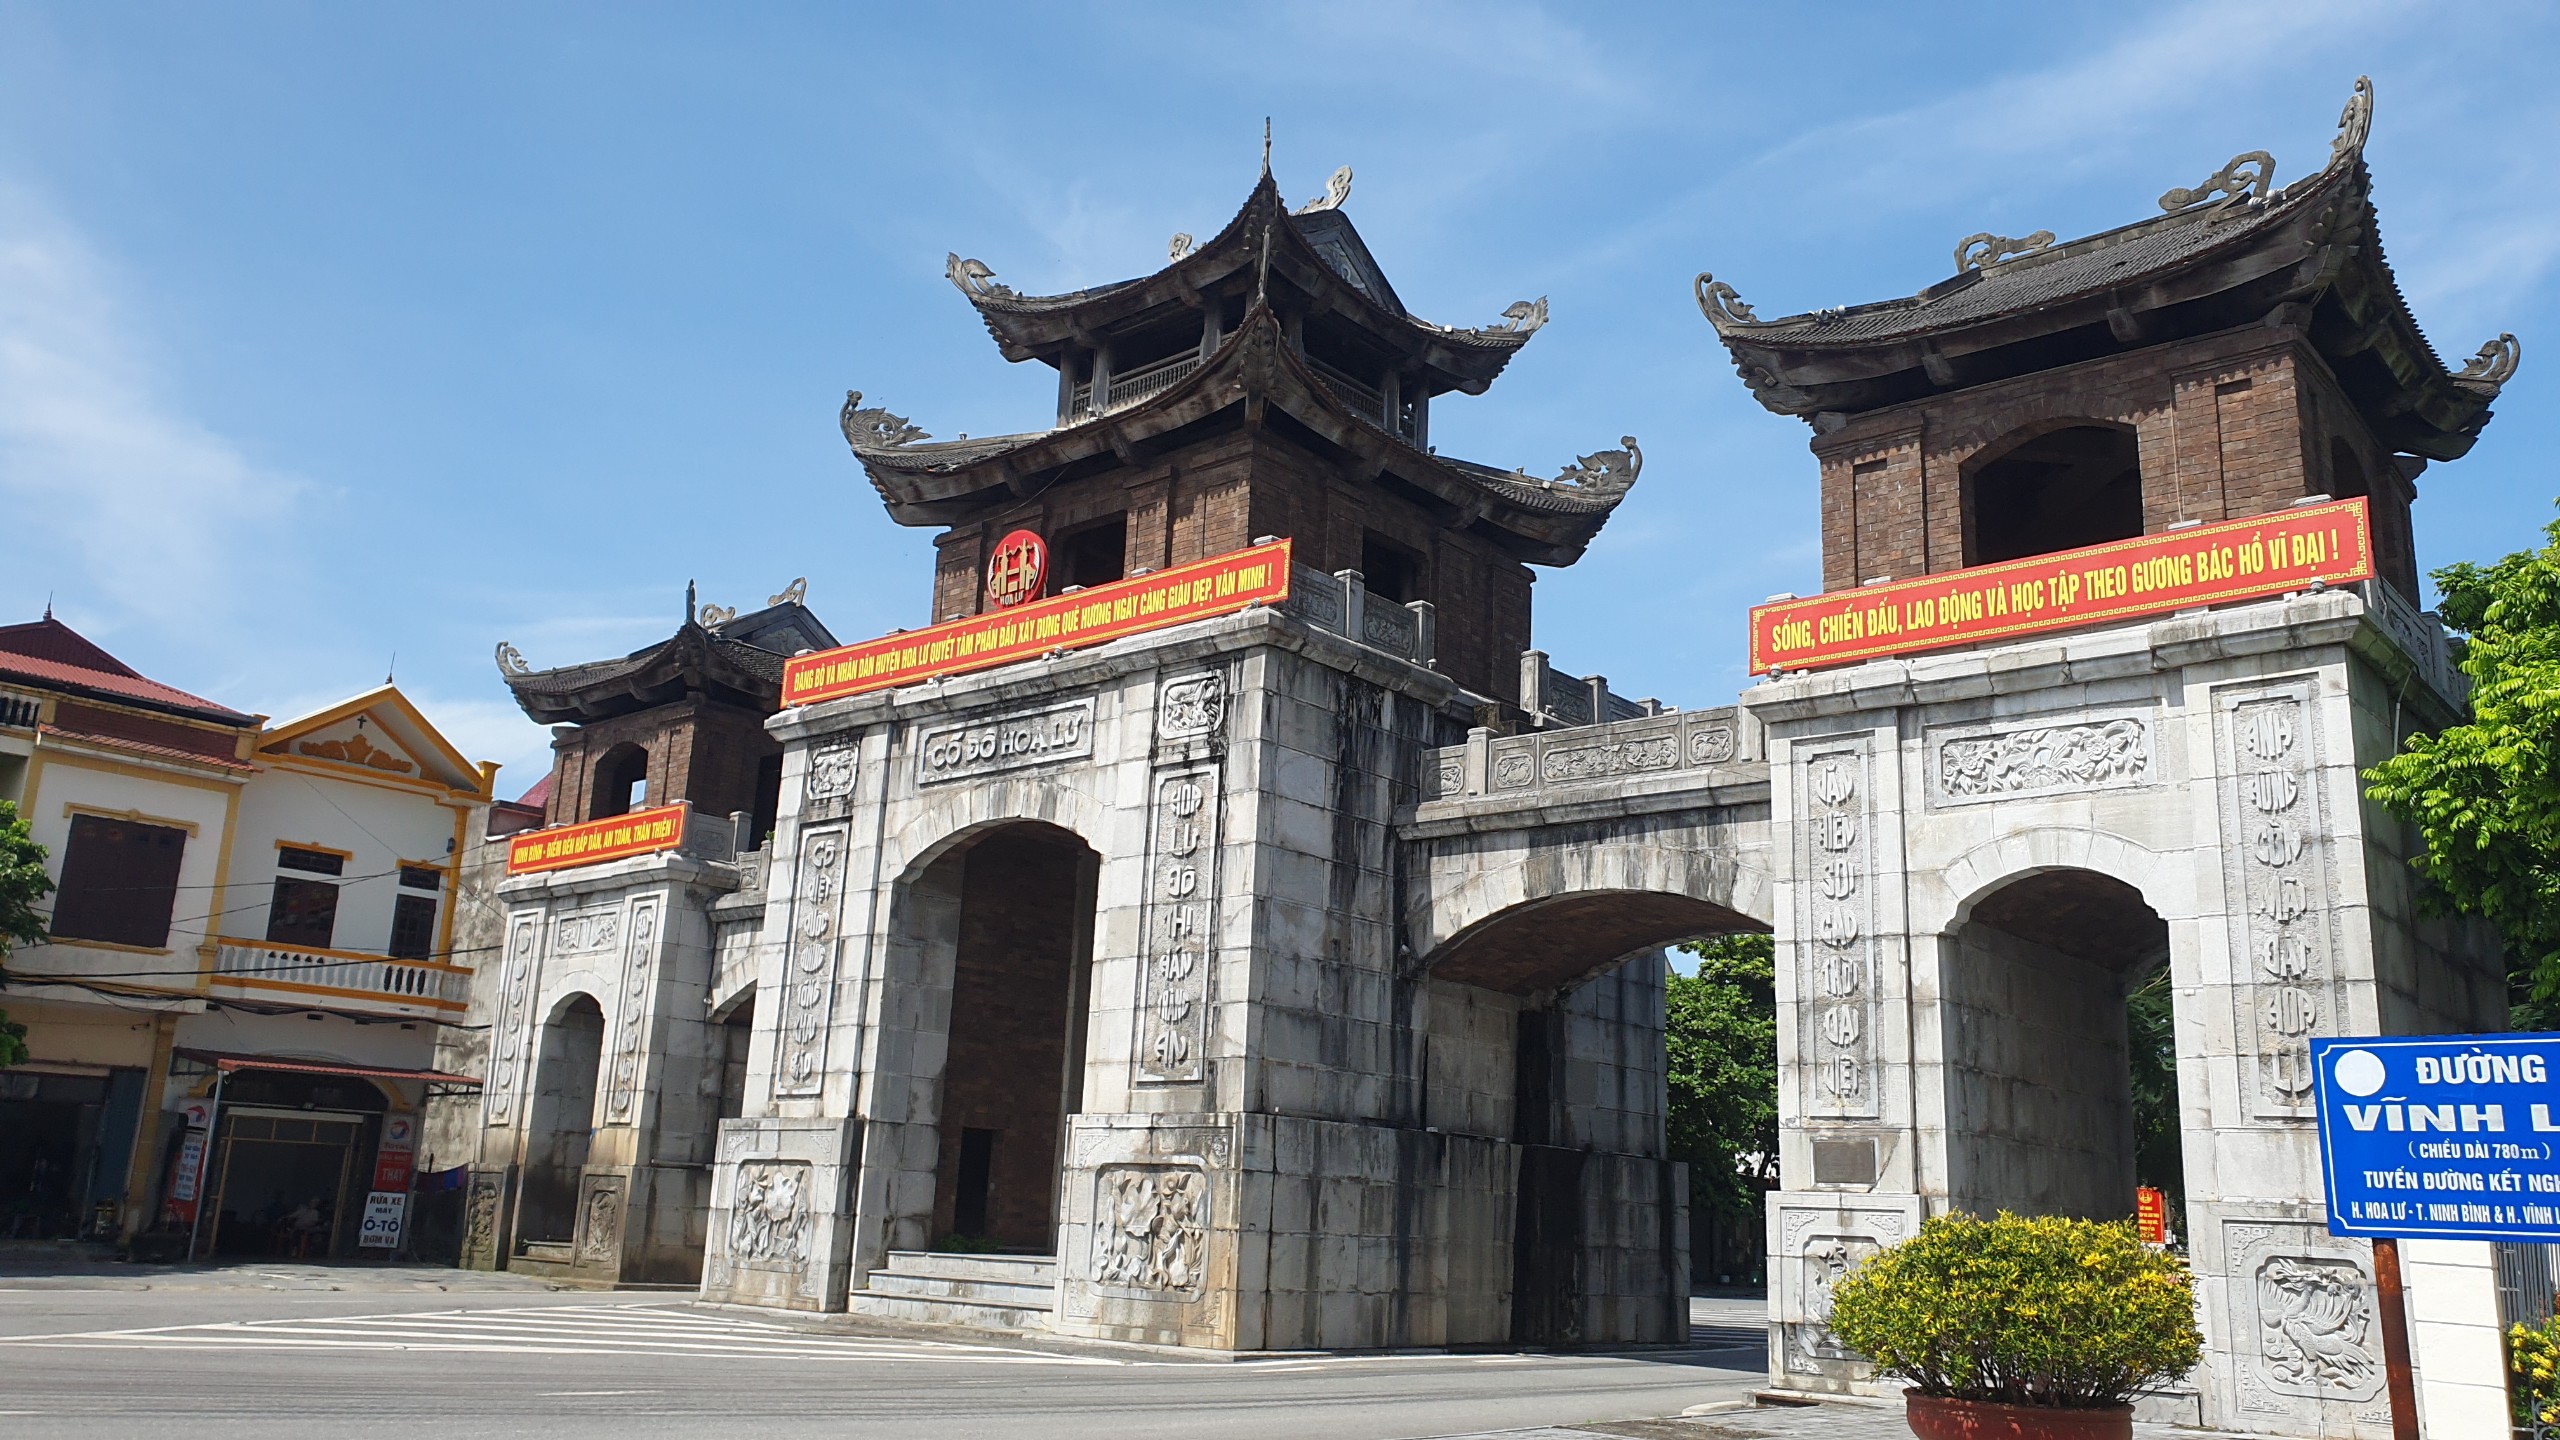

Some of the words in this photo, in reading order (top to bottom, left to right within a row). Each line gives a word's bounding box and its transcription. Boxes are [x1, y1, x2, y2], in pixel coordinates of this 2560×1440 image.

[1000, 593, 1014, 605] HOA
[1772, 614, 1815, 653] SỐNG,
[1819, 604, 1864, 645] CHIẾN
[1867, 597, 1903, 637] ĐẤU,
[1906, 599, 1935, 631] LAO
[1938, 588, 1982, 629] ĐỘNG
[1986, 582, 2008, 617] VÀ
[2011, 577, 2044, 618] HỌC
[2048, 569, 2080, 612] TẬP
[2084, 565, 2127, 601] THEO
[2131, 554, 2193, 594] GƯƠNG
[2196, 542, 2234, 583] BÁC
[2238, 531, 2264, 576] HỒ
[2268, 532, 2289, 571] VĨ
[2292, 530, 2326, 571] ĐẠI
[793, 664, 814, 692] ĐẢNG
[814, 663, 825, 691] BỘ
[826, 660, 836, 686] VÀ
[836, 656, 858, 683] NHÂN
[858, 652, 875, 678] DÂN
[875, 647, 901, 676] HUYỆN
[901, 646, 917, 670] HOA
[918, 641, 931, 666] LƯ
[929, 632, 955, 665] QUYẾT
[956, 631, 973, 657] TÂM
[975, 622, 998, 652] PHẤN
[998, 618, 1017, 647] ĐẤU
[1017, 617, 1036, 643] XÂY
[1036, 613, 1060, 643] DỰNG
[1061, 605, 1080, 636] QUÊ
[1081, 601, 1112, 630] HƯƠNG
[1113, 592, 1139, 622] NGÀY
[1139, 587, 1166, 616] CÀNG
[1167, 579, 1191, 608] GIÀU
[1192, 577, 1213, 607] ĐẸP,
[1215, 568, 1236, 598] VĂN
[1237, 564, 1266, 593] MINH
[930, 731, 966, 768] CỐ
[966, 728, 997, 760] ĐÔ
[1001, 727, 1048, 756] HOA
[1051, 713, 1084, 746] LƯ
[513, 846, 529, 865] NINH
[528, 841, 543, 862] BÌNH
[603, 829, 614, 848] AN
[2415, 1047, 2547, 1085] ĐƯỜNG
[2342, 1096, 2505, 1132] VĨNH
[2465, 1140, 2490, 1159] DÀI
[2363, 1166, 2418, 1190] TUYẾN
[2422, 1168, 2484, 1191] ĐƯỜNG
[2489, 1168, 2522, 1192] KẾT
[391, 1197, 403, 1206] XE
[2351, 1201, 2363, 1219] H.
[2365, 1202, 2389, 1220] HOA
[2391, 1201, 2406, 1220] LƯ
[2428, 1203, 2459, 1222] NINH
[2461, 1201, 2491, 1223] BÌNH
[2494, 1206, 2504, 1223] &
[2522, 1202, 2553, 1225] VĨNH
[364, 1215, 399, 1232] Ô-TÔ
